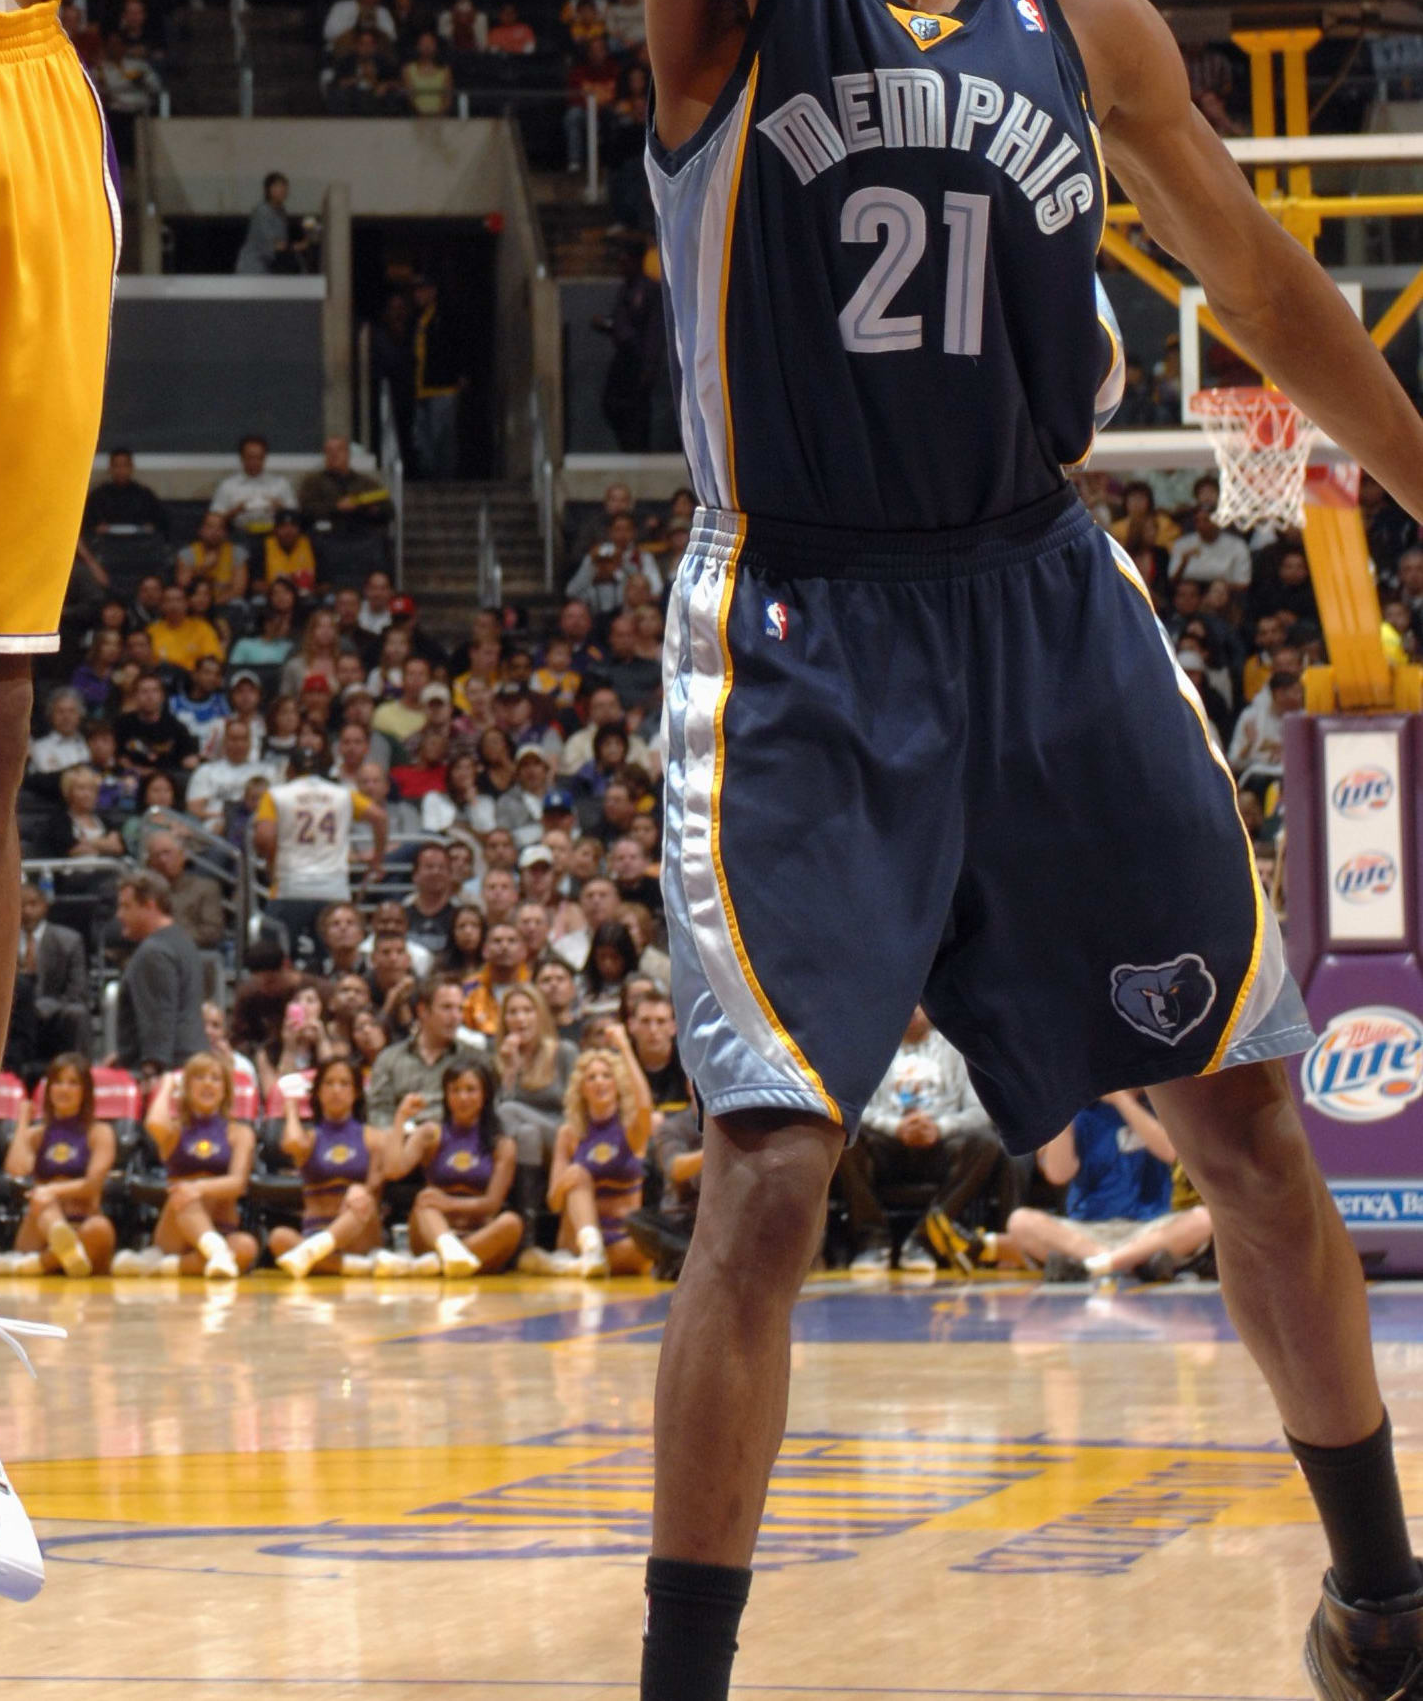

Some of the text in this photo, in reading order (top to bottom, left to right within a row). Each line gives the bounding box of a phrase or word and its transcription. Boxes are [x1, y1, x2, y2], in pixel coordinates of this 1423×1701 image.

[756, 68, 1094, 235] MEMPHIS
[838, 186, 991, 355] 21
[296, 810, 336, 844] 24
[1319, 1040, 1423, 1094] Lite
